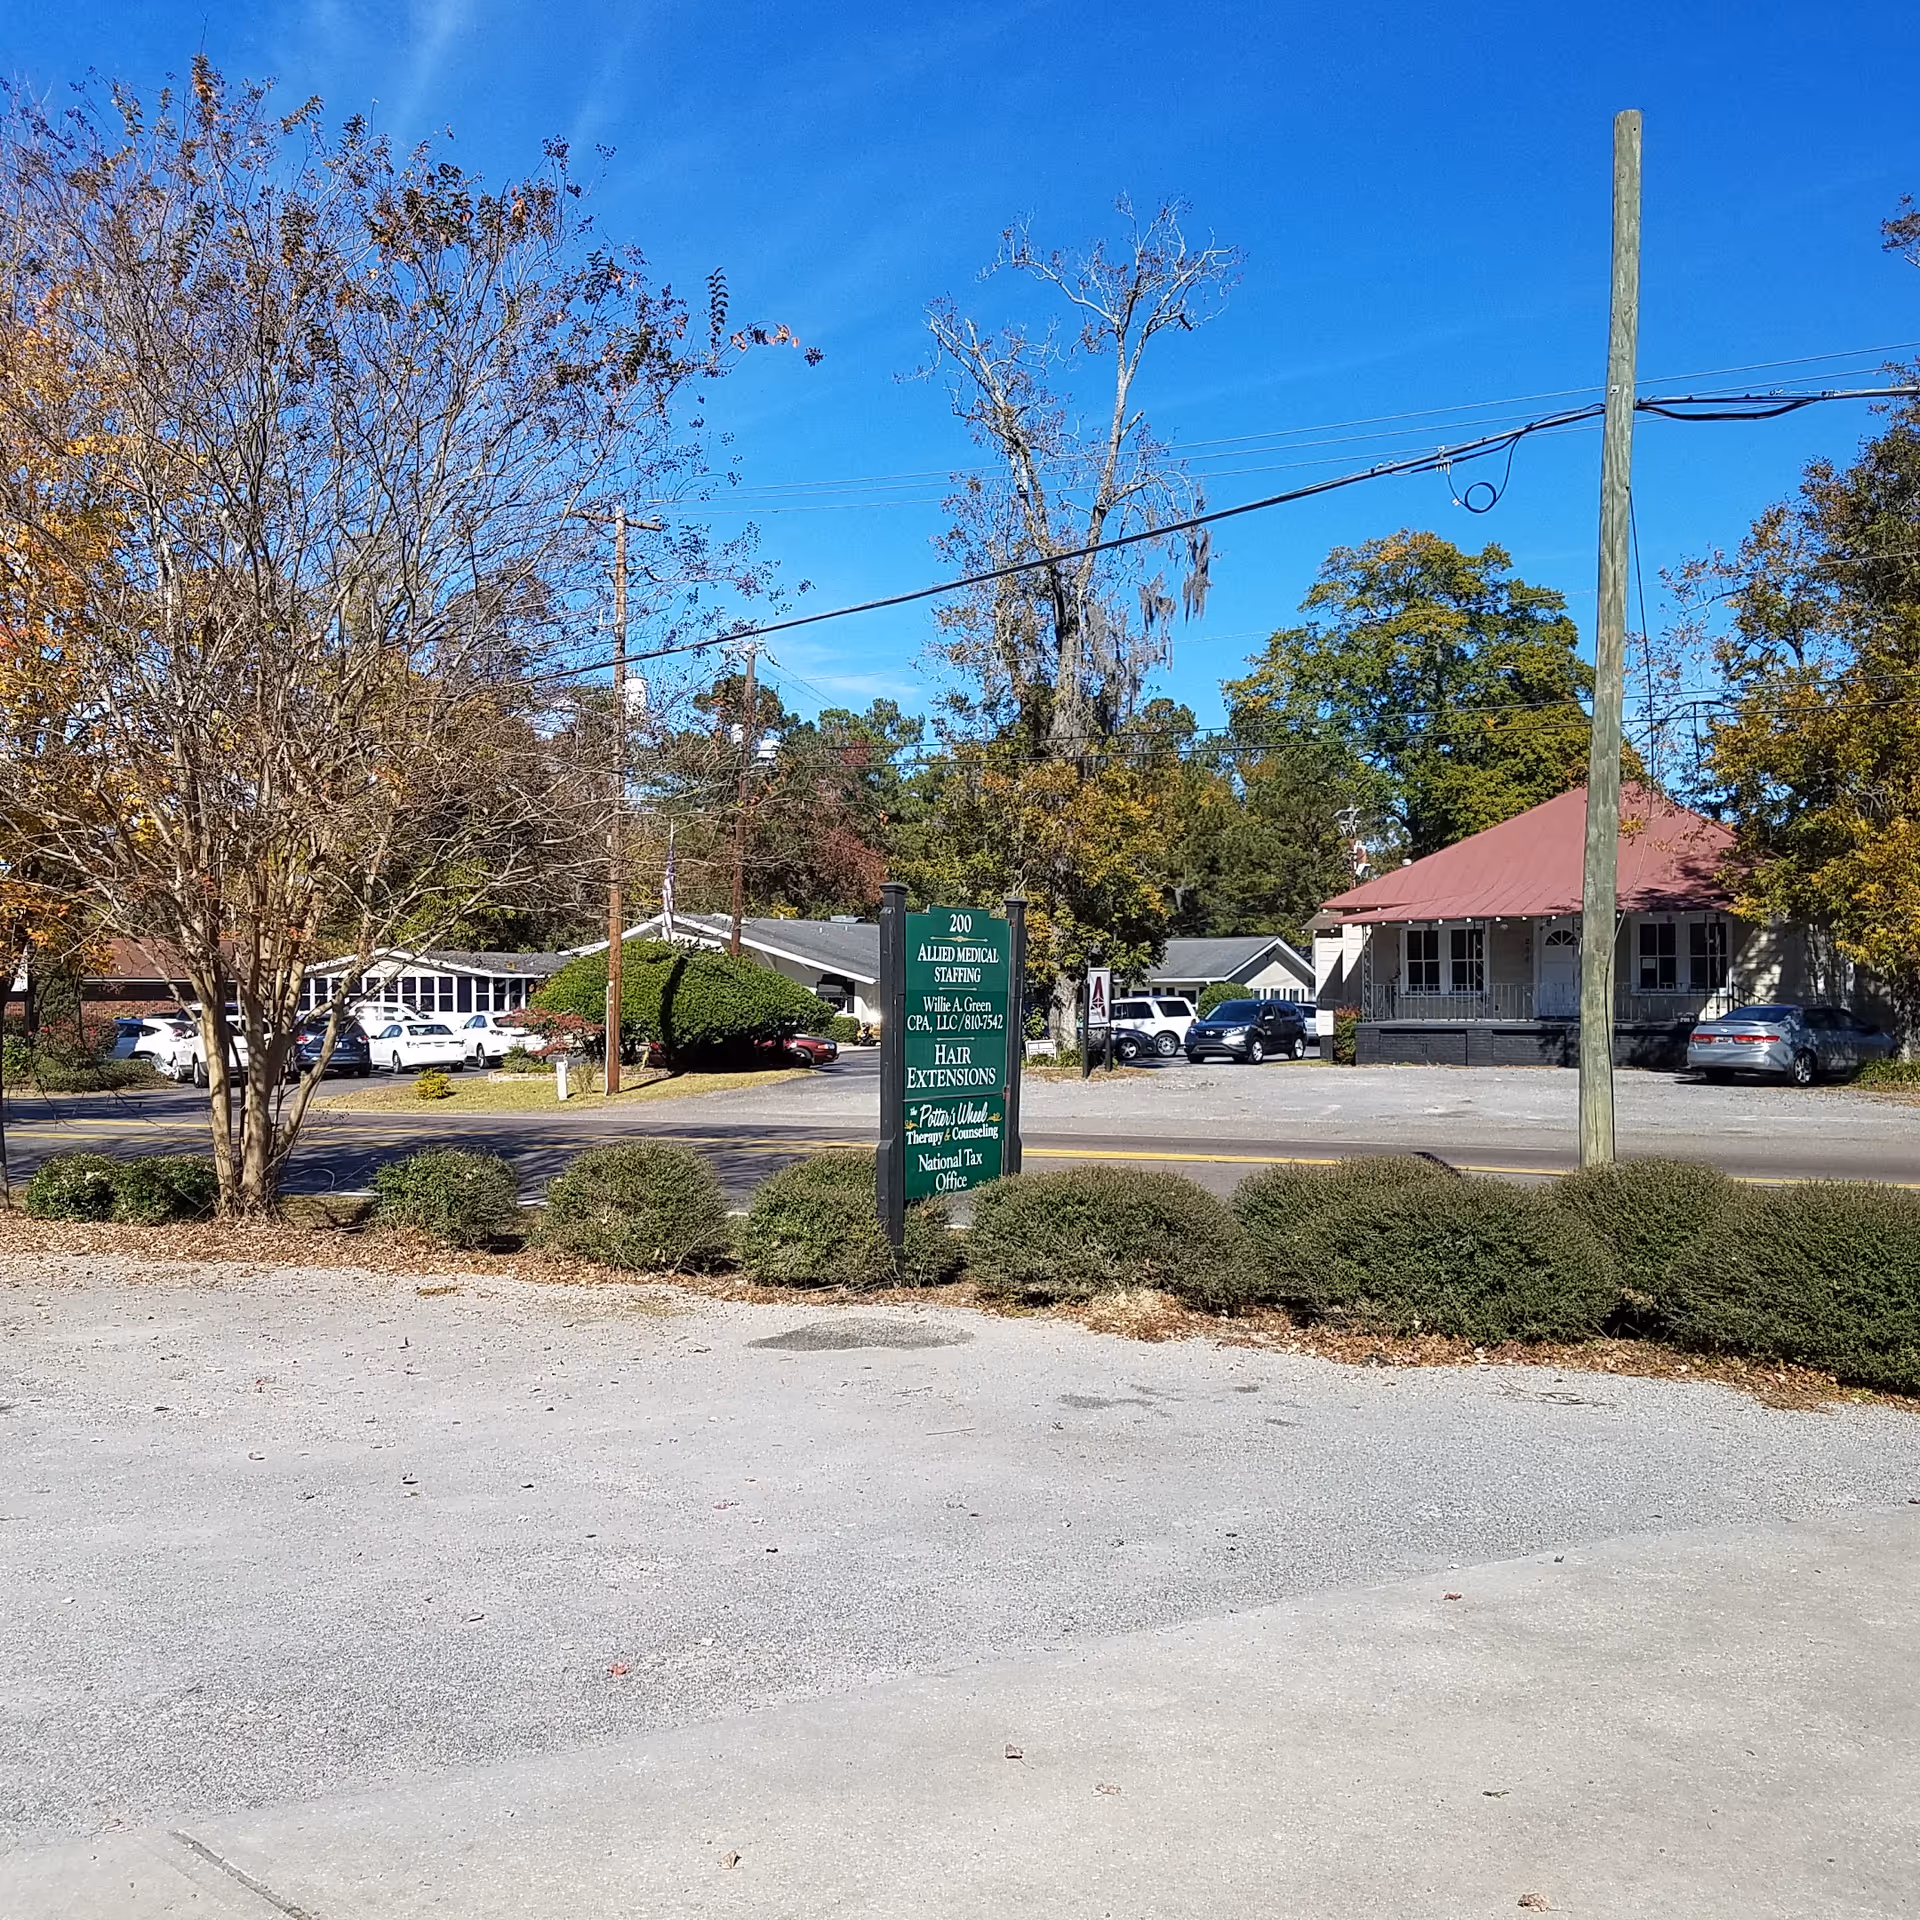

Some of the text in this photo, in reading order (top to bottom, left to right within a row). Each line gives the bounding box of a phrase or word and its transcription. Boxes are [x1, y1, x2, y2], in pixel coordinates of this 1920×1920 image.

[949, 914, 972, 933] 200
[917, 943, 999, 963] ALLIED MEDICAL
[934, 966, 981, 983] STAFFING
[922, 996, 951, 1012] Willie
[964, 997, 991, 1012] Green
[907, 1014, 933, 1033] CPA,
[934, 1044, 972, 1066] HAIR
[906, 1067, 996, 1089] EXTENSIONS
[909, 1101, 988, 1129] The Potter's Wheel
[906, 1125, 999, 1147] Therapy & Counseling
[918, 1148, 983, 1173] National Tax
[935, 1170, 968, 1192] Office
